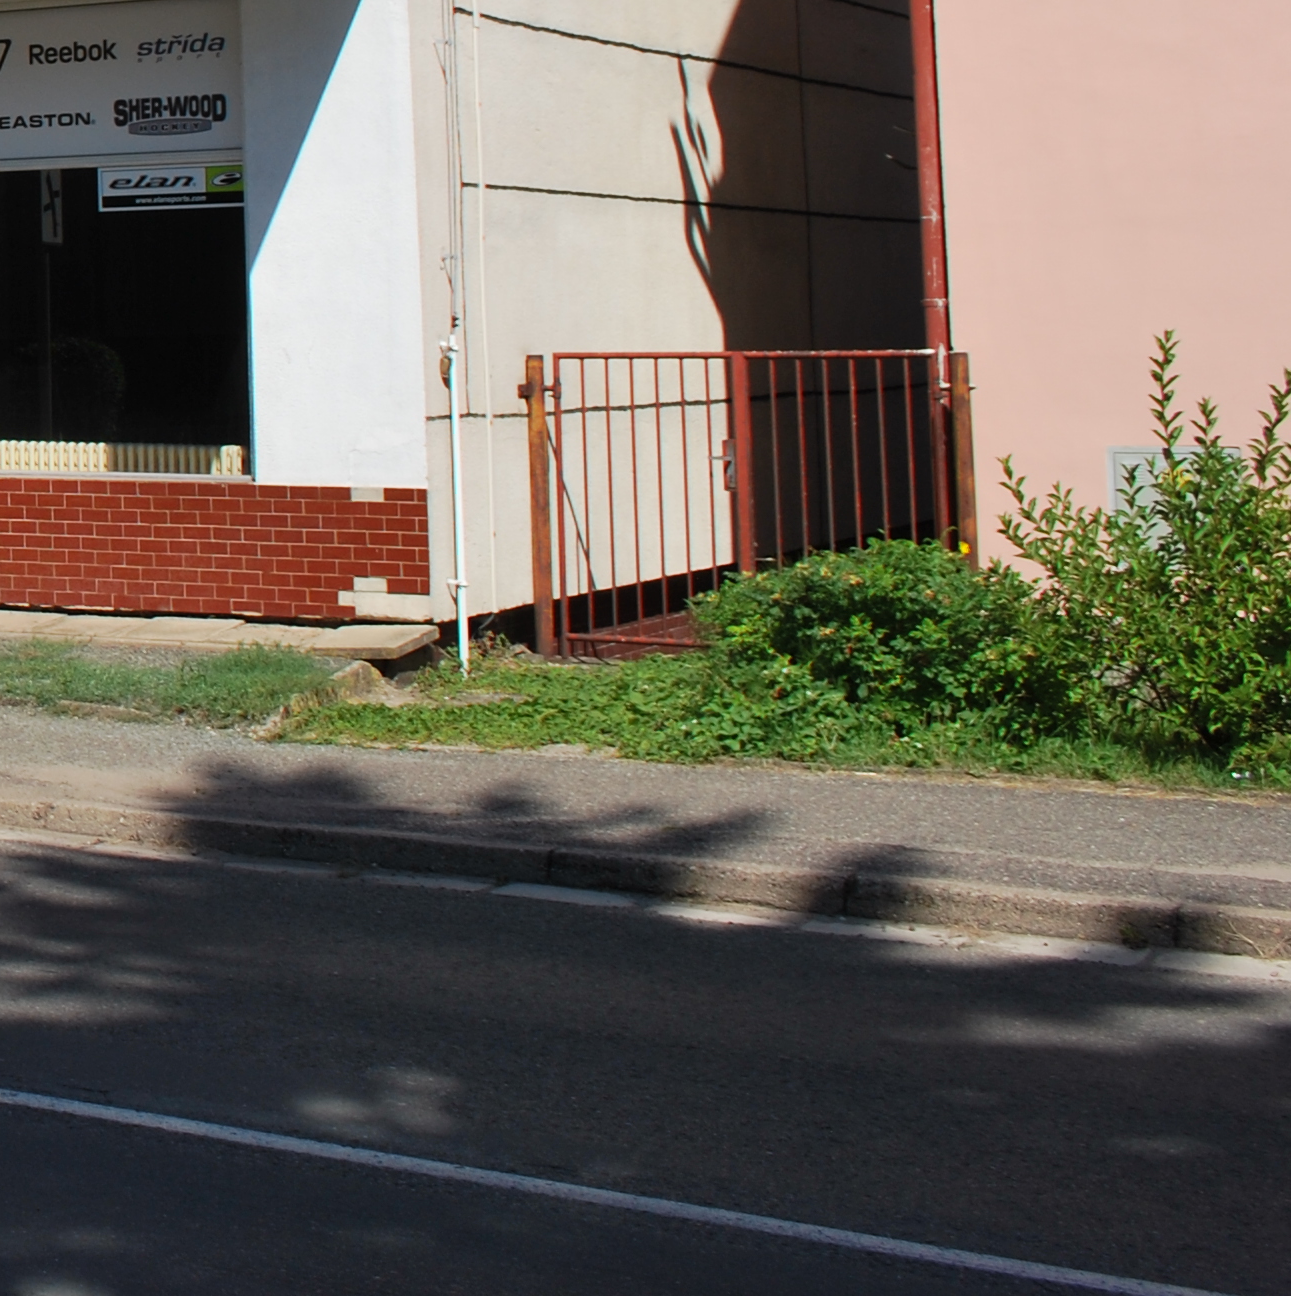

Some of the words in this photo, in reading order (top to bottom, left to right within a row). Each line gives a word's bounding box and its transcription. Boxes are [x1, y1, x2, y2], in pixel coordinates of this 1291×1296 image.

[28, 39, 118, 65] Reebok
[137, 32, 226, 56] střída
[113, 93, 227, 127] SHER-WOOD
[139, 122, 199, 132] HOCKEY
[107, 173, 195, 190] elan
